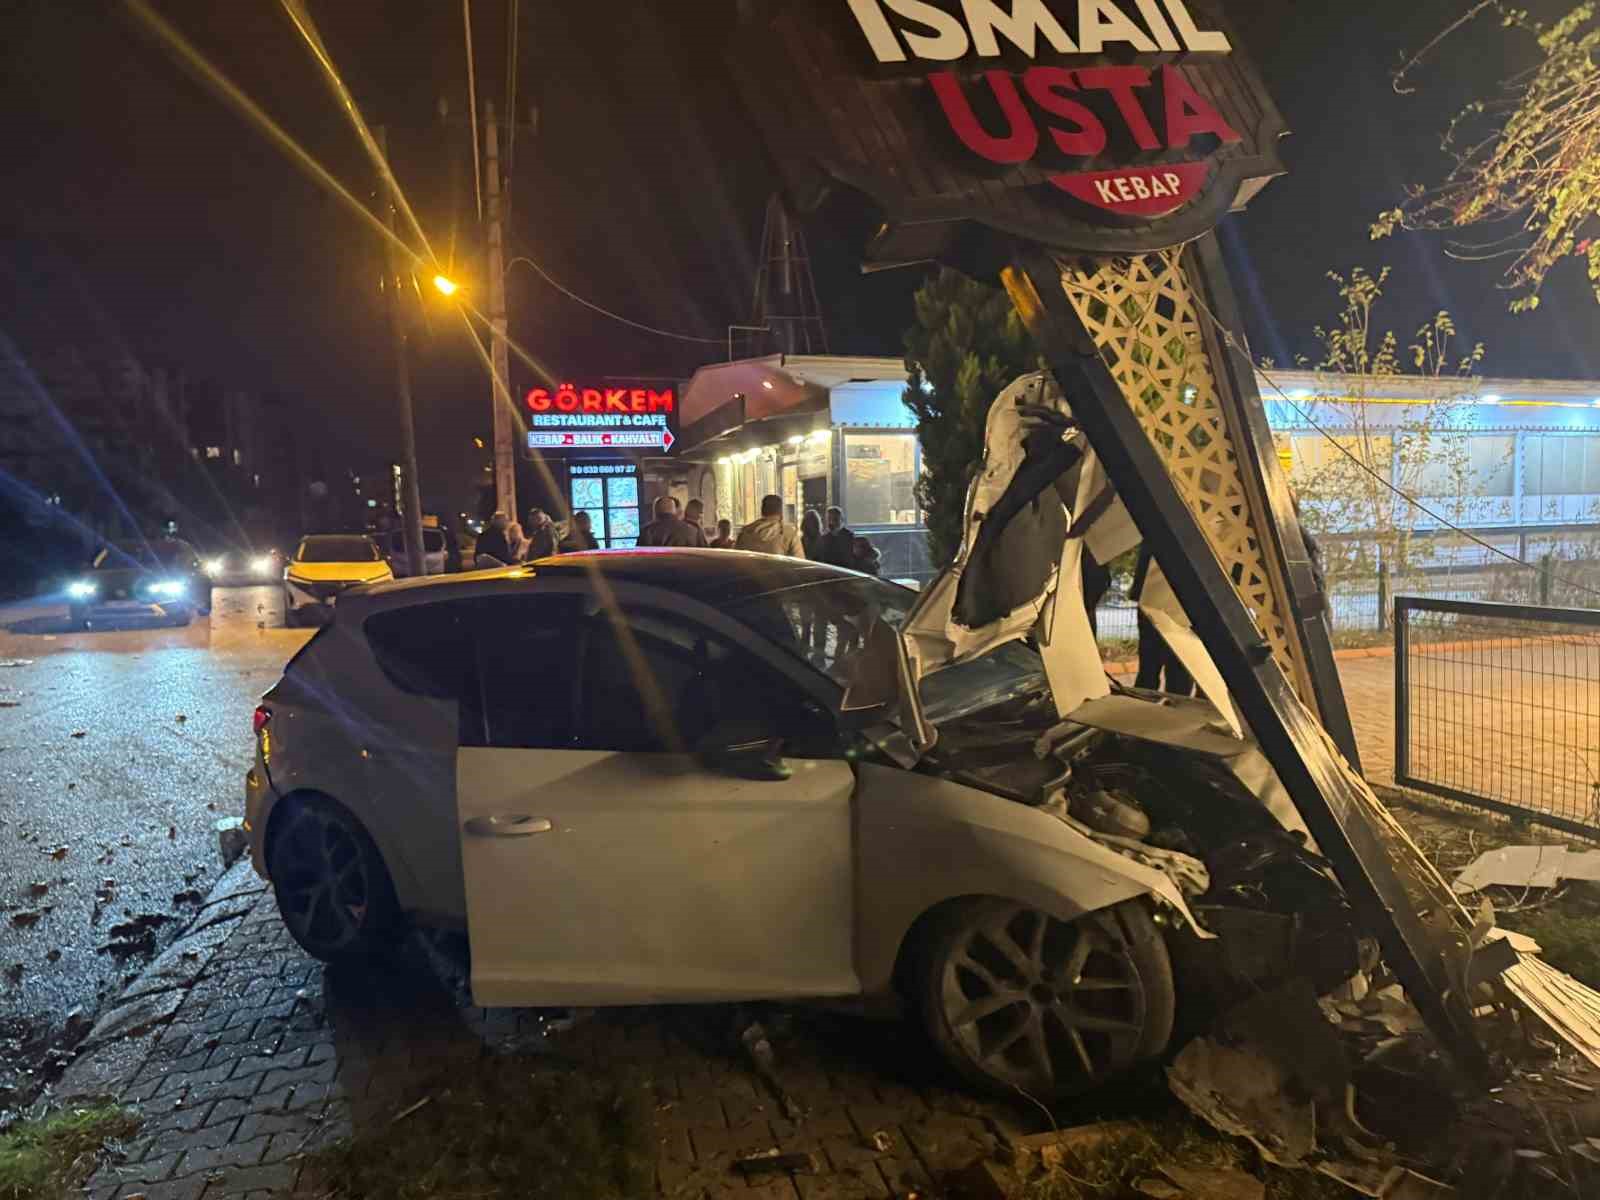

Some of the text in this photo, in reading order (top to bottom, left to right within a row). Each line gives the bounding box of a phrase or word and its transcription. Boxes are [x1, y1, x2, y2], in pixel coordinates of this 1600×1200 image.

[927, 63, 1243, 164] USTA
[1094, 173, 1181, 204] KEBAP
[527, 384, 673, 412] GÖRKEM
